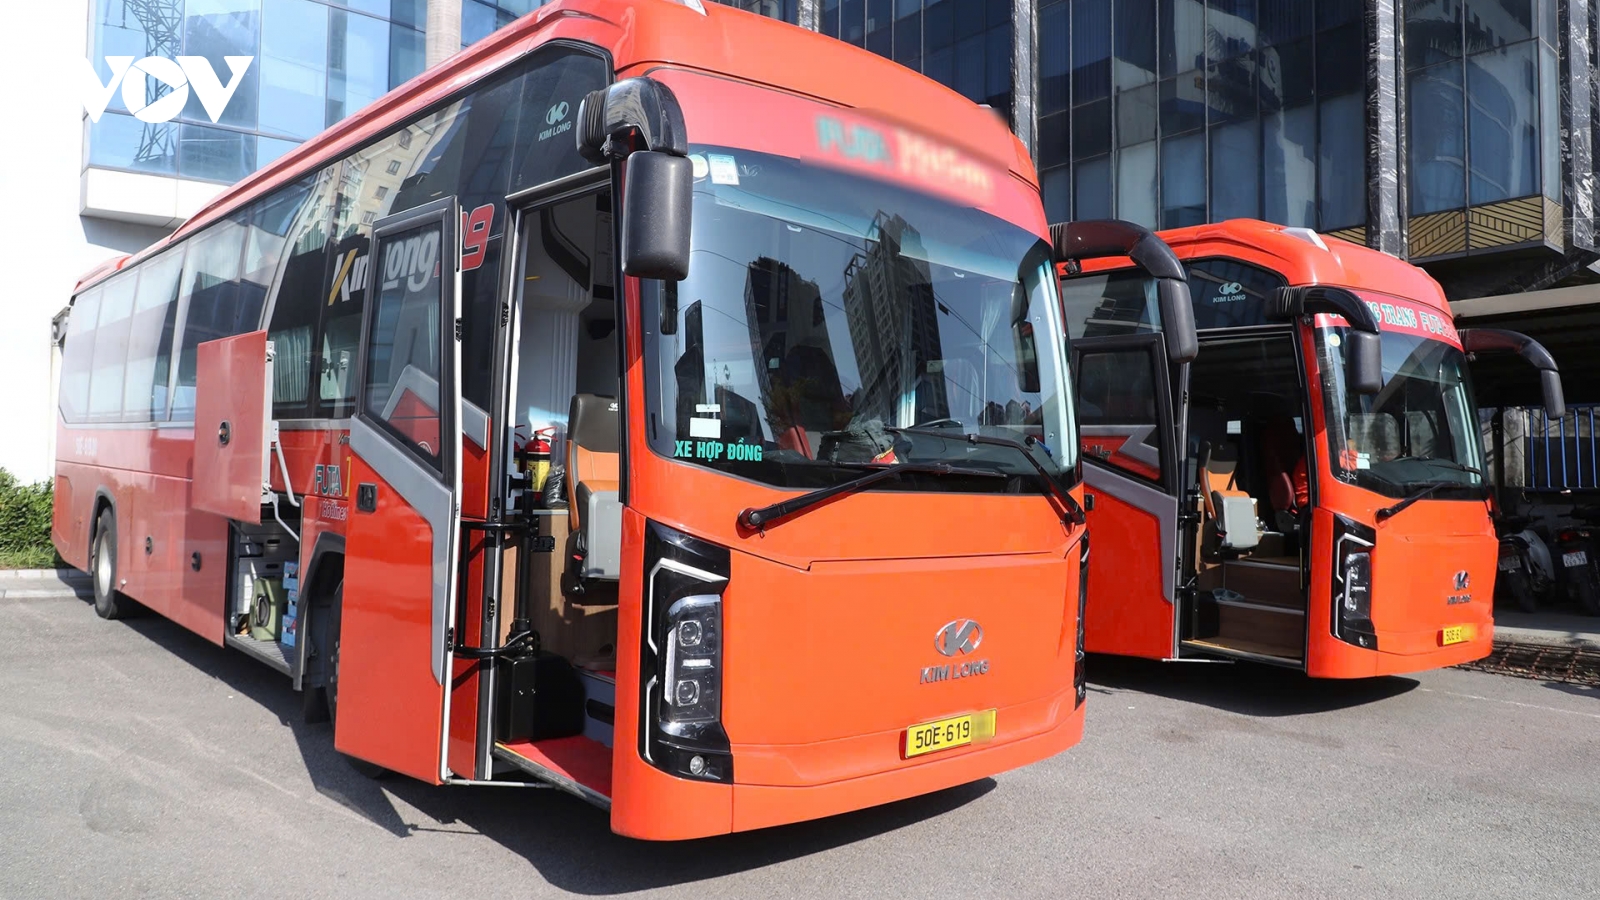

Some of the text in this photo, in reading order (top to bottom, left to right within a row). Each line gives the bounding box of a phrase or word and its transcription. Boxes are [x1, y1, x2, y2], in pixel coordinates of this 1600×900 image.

[538, 121, 571, 141] KIM LONG
[1227, 294, 1246, 302] LONG
[1380, 302, 1418, 328] TRANG
[673, 436, 763, 462] XE HỢP ĐỒNG
[314, 464, 342, 497] FUTA
[920, 659, 990, 684] KIM LONG
[916, 719, 973, 749] 50E-619
